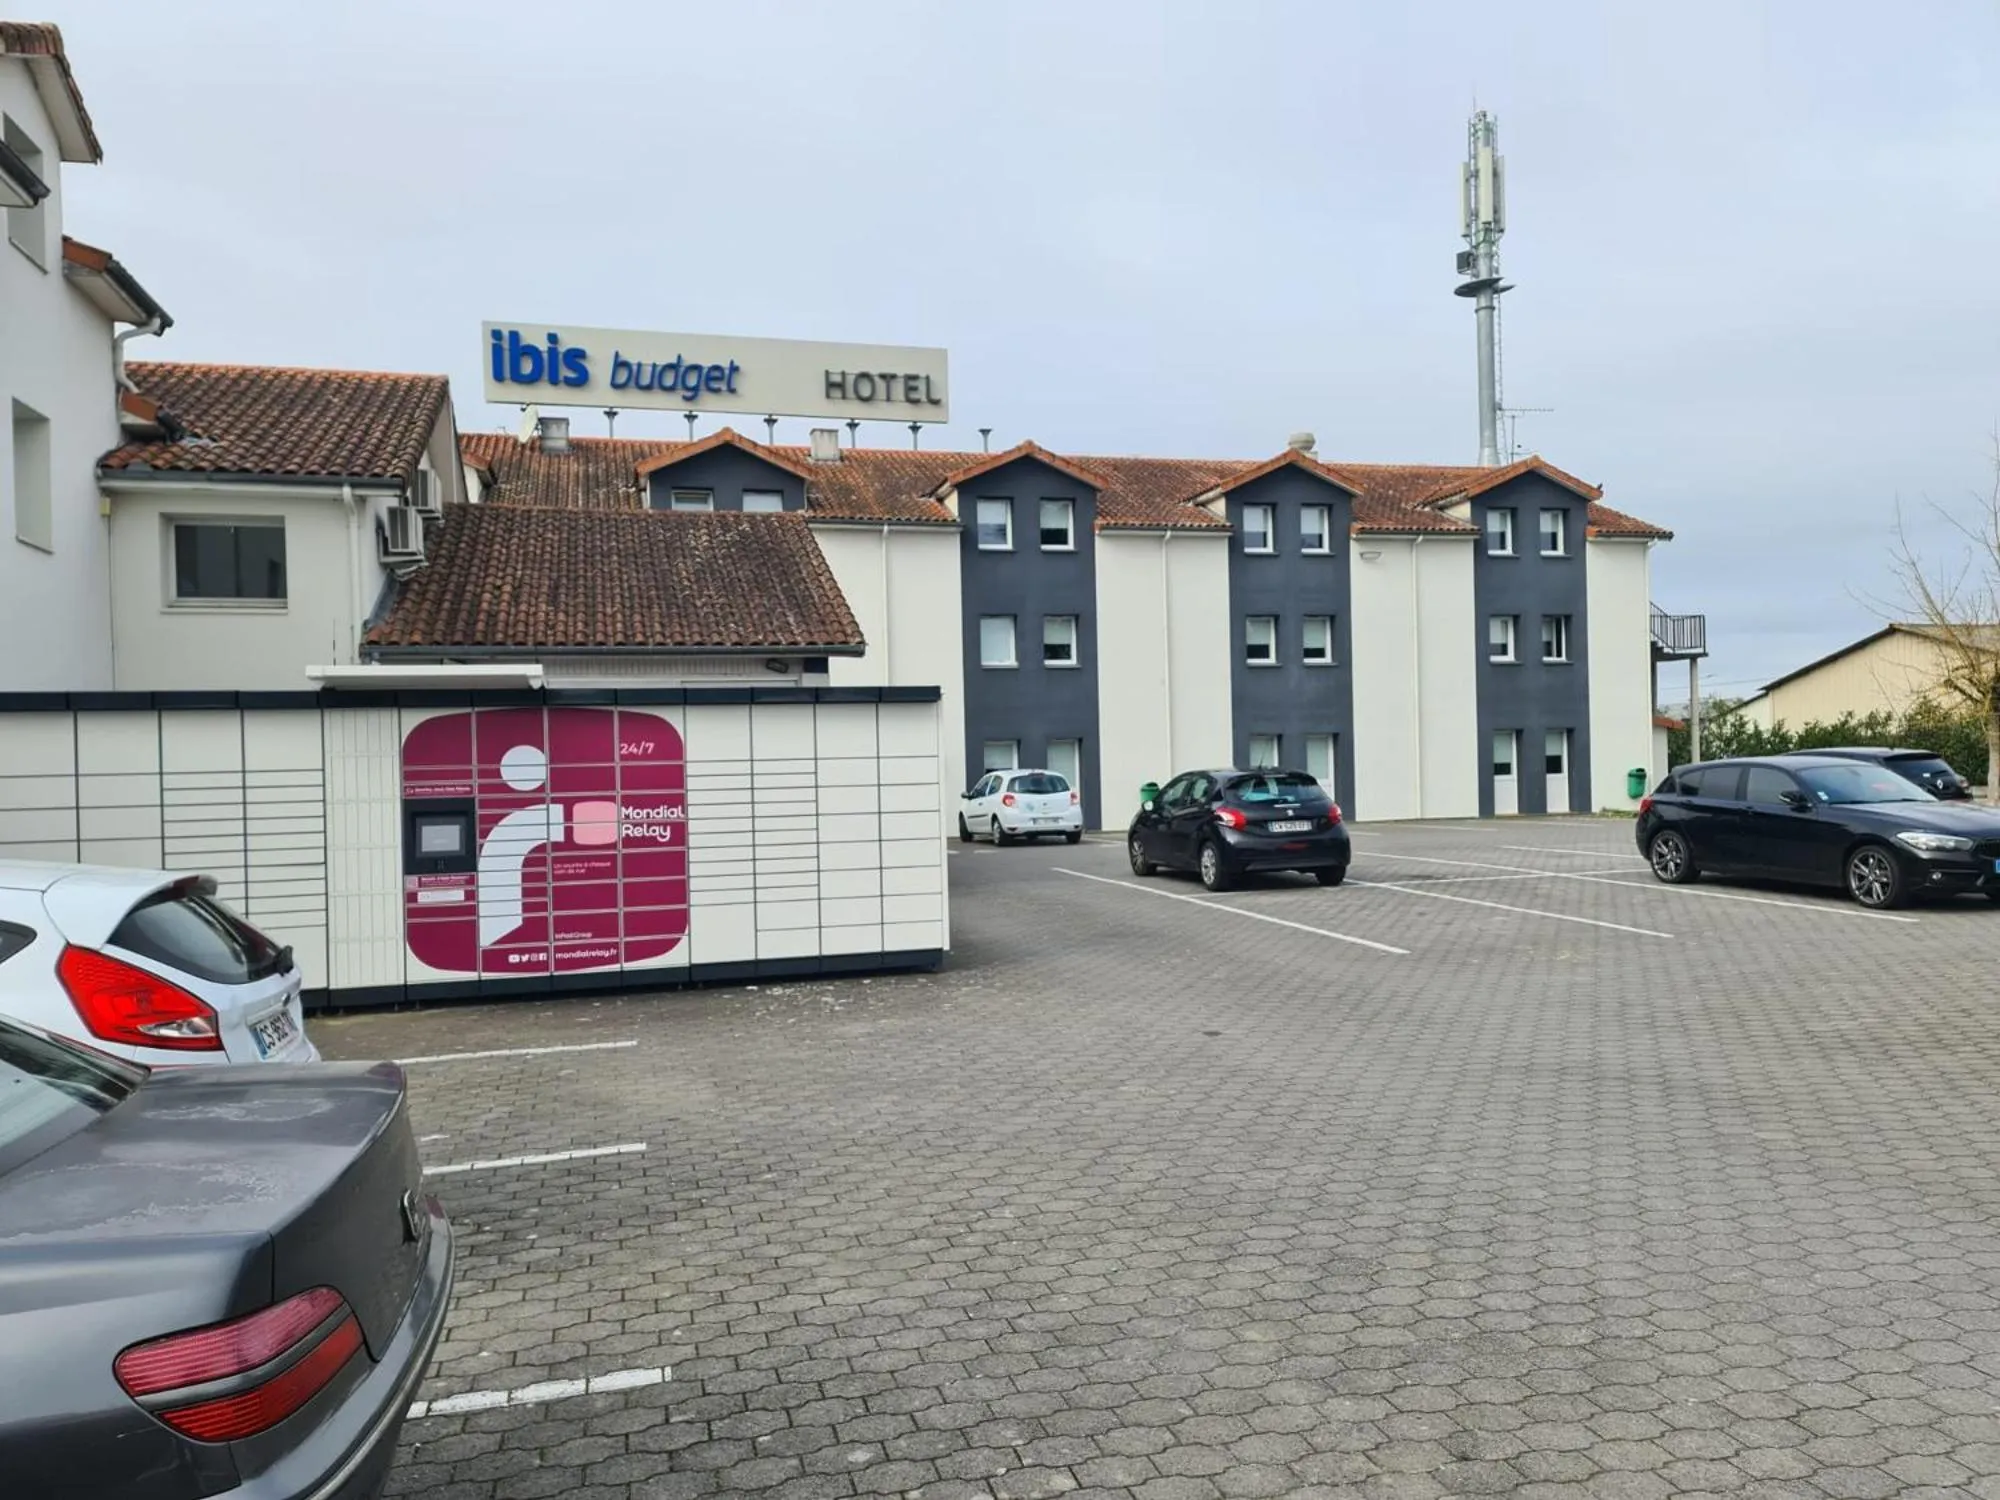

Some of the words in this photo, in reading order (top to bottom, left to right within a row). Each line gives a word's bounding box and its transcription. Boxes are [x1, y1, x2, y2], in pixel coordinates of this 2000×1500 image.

[490, 329, 590, 388] ibis
[610, 350, 740, 402] budget
[824, 369, 942, 405] HOTEL
[620, 741, 655, 756] 24/7
[621, 805, 685, 819] Mondial
[622, 823, 671, 842] Relay
[555, 948, 618, 960] mondialrelay.fr
